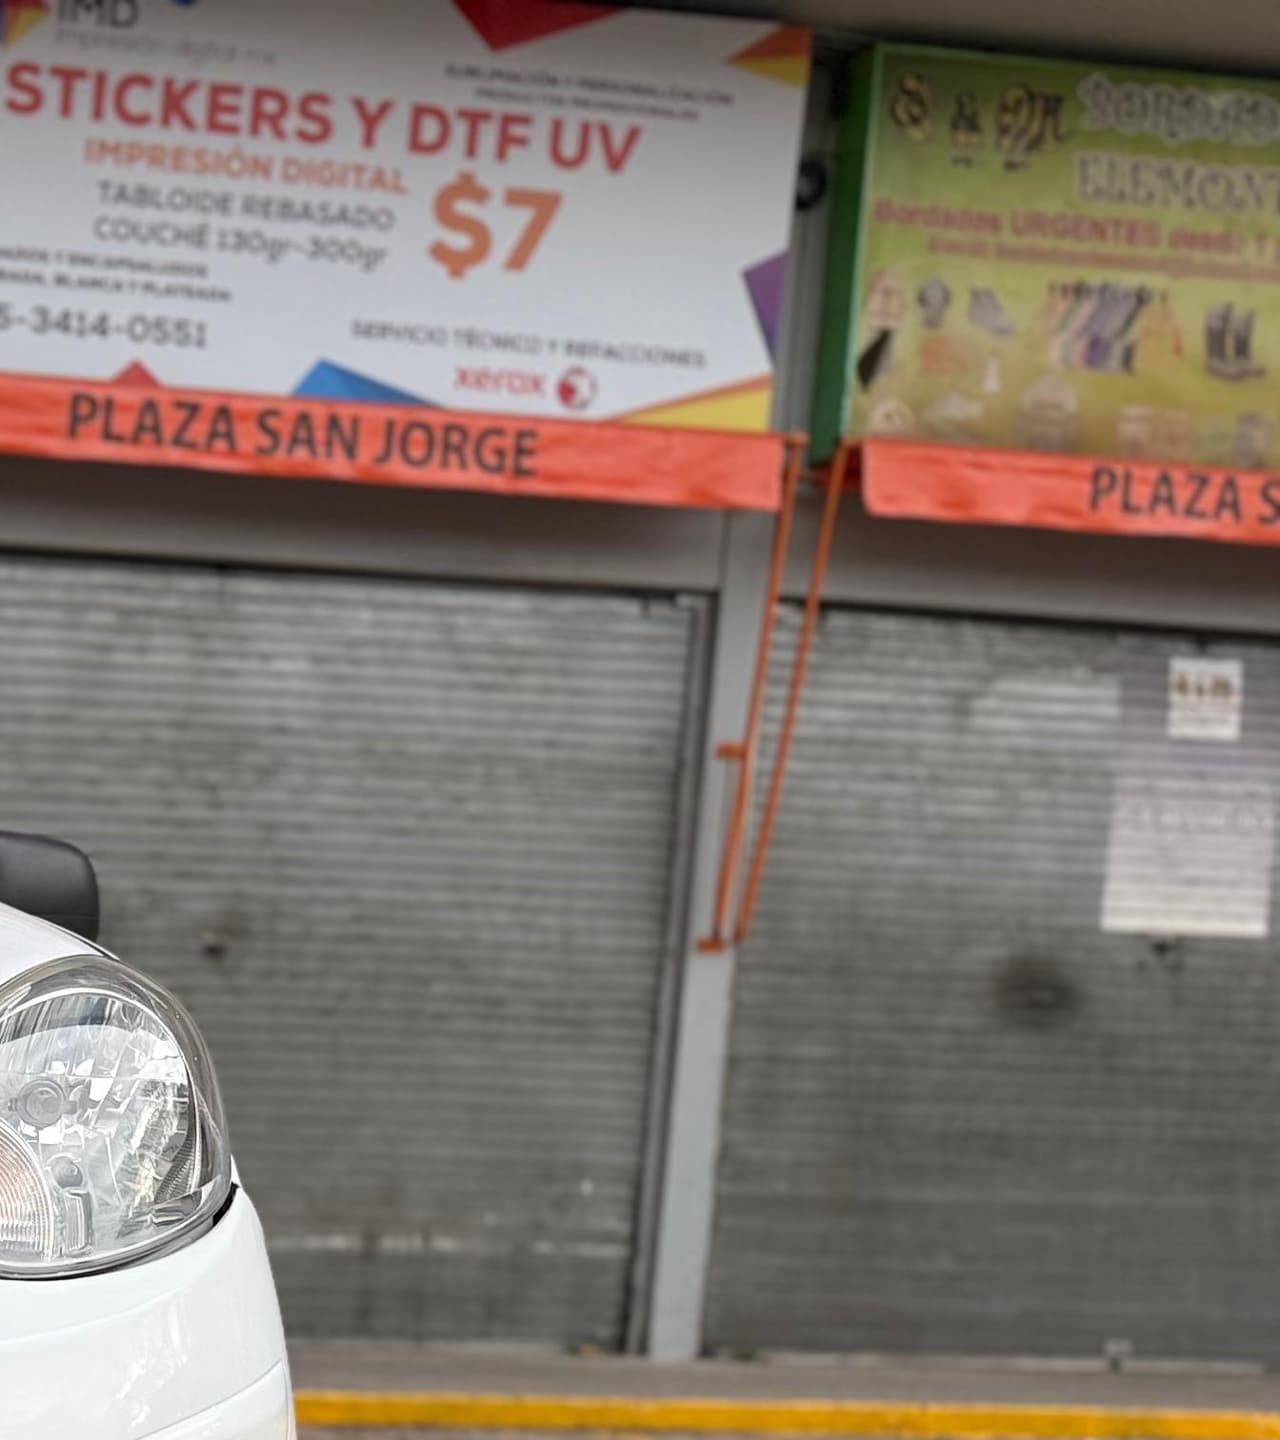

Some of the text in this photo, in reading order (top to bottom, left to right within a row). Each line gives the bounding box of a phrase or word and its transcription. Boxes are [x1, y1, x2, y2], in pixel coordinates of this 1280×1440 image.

[4, 60, 645, 175] STICKERS Y DTF UV
[84, 136, 410, 196] IMPRESIÓN DIGITAL
[92, 214, 211, 252] COUCHÉ
[98, 179, 397, 232] TABLOIDE REBASADO
[428, 170, 565, 281] $7
[351, 318, 449, 349] SERVICIO
[454, 365, 548, 396] xerox
[67, 391, 539, 478] PLAZA SAN JORGE
[1087, 466, 1243, 524] PLAZA
